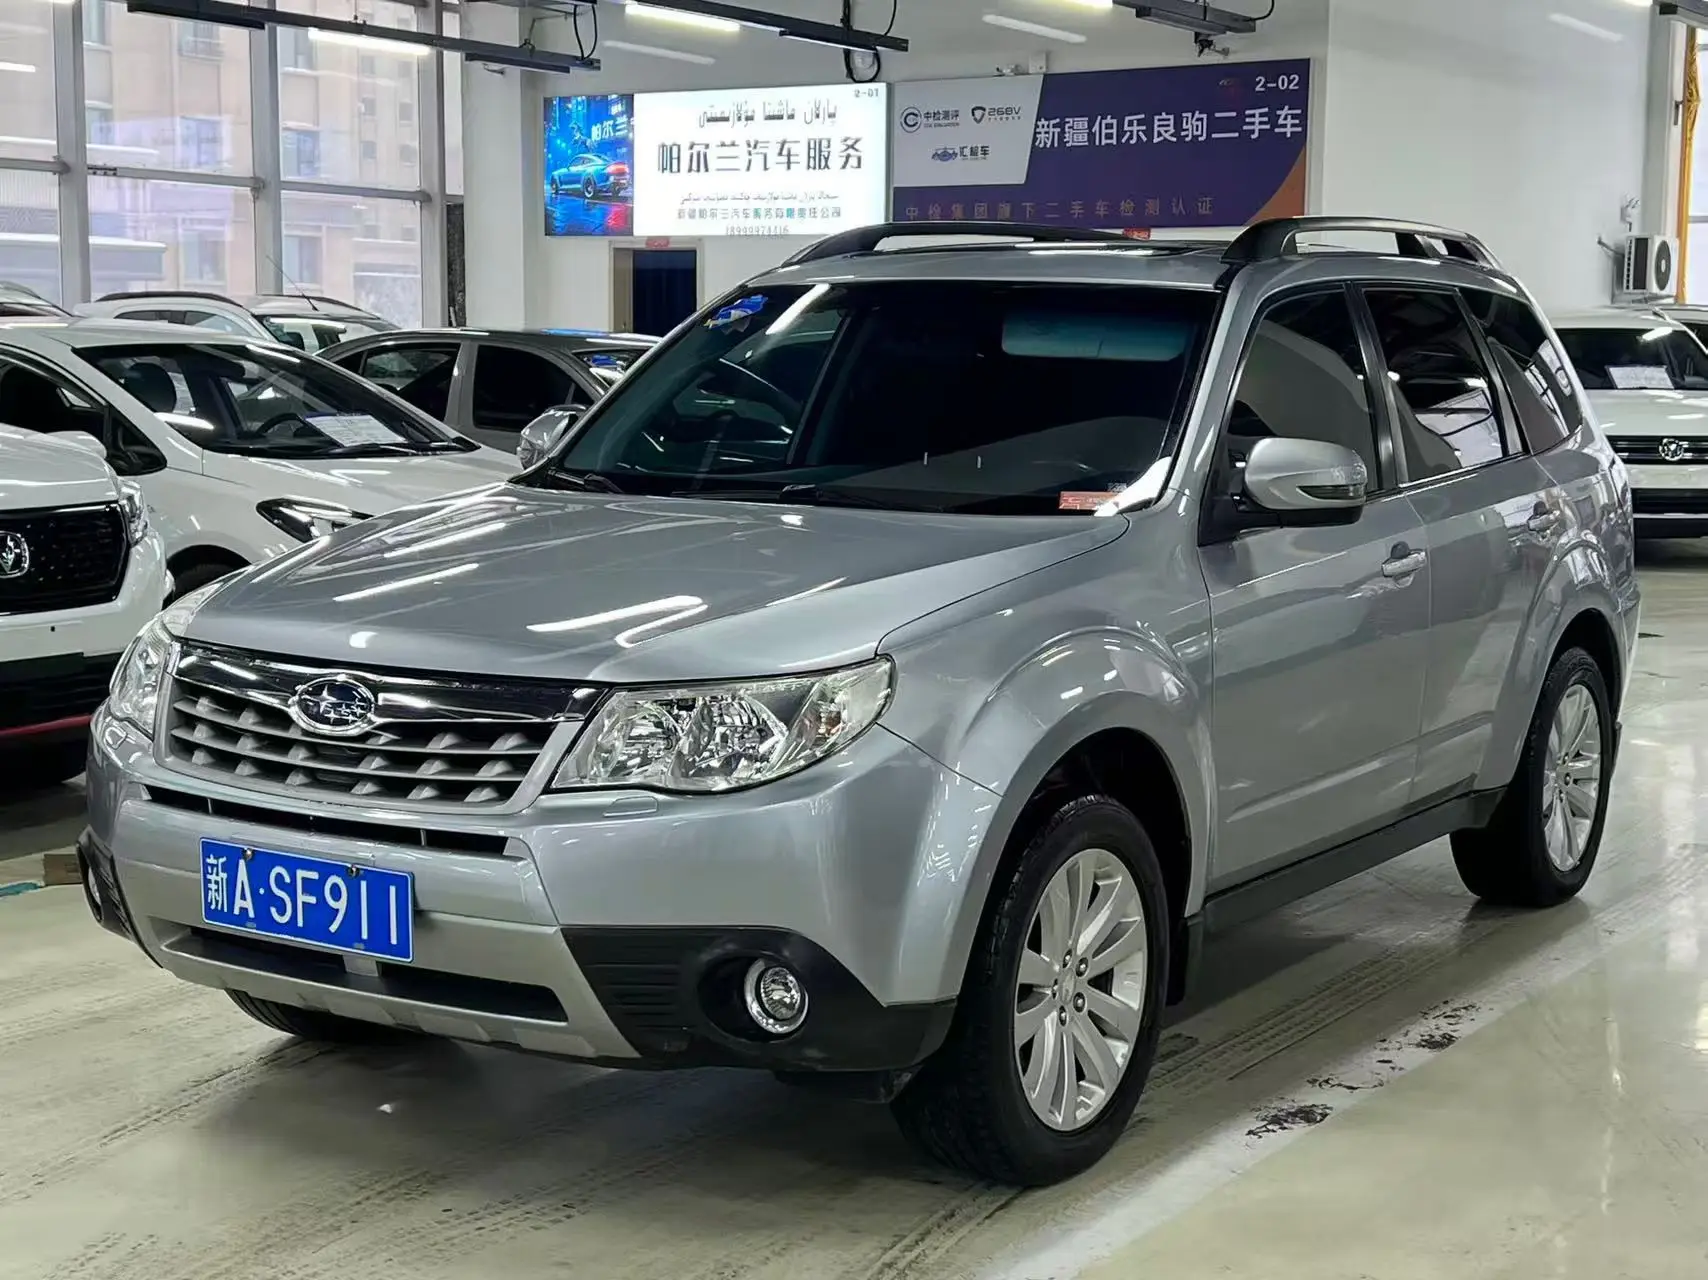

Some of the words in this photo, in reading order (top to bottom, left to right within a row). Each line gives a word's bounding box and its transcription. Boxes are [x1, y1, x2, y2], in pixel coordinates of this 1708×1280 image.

[1255, 74, 1300, 92] 2-02
[988, 106, 1021, 116] 268V
[1035, 105, 1302, 148] 新疆伯乐良驹二手车
[657, 136, 863, 173] 帕尔兰汽车服务
[206, 854, 397, 944] 新A·SF911
